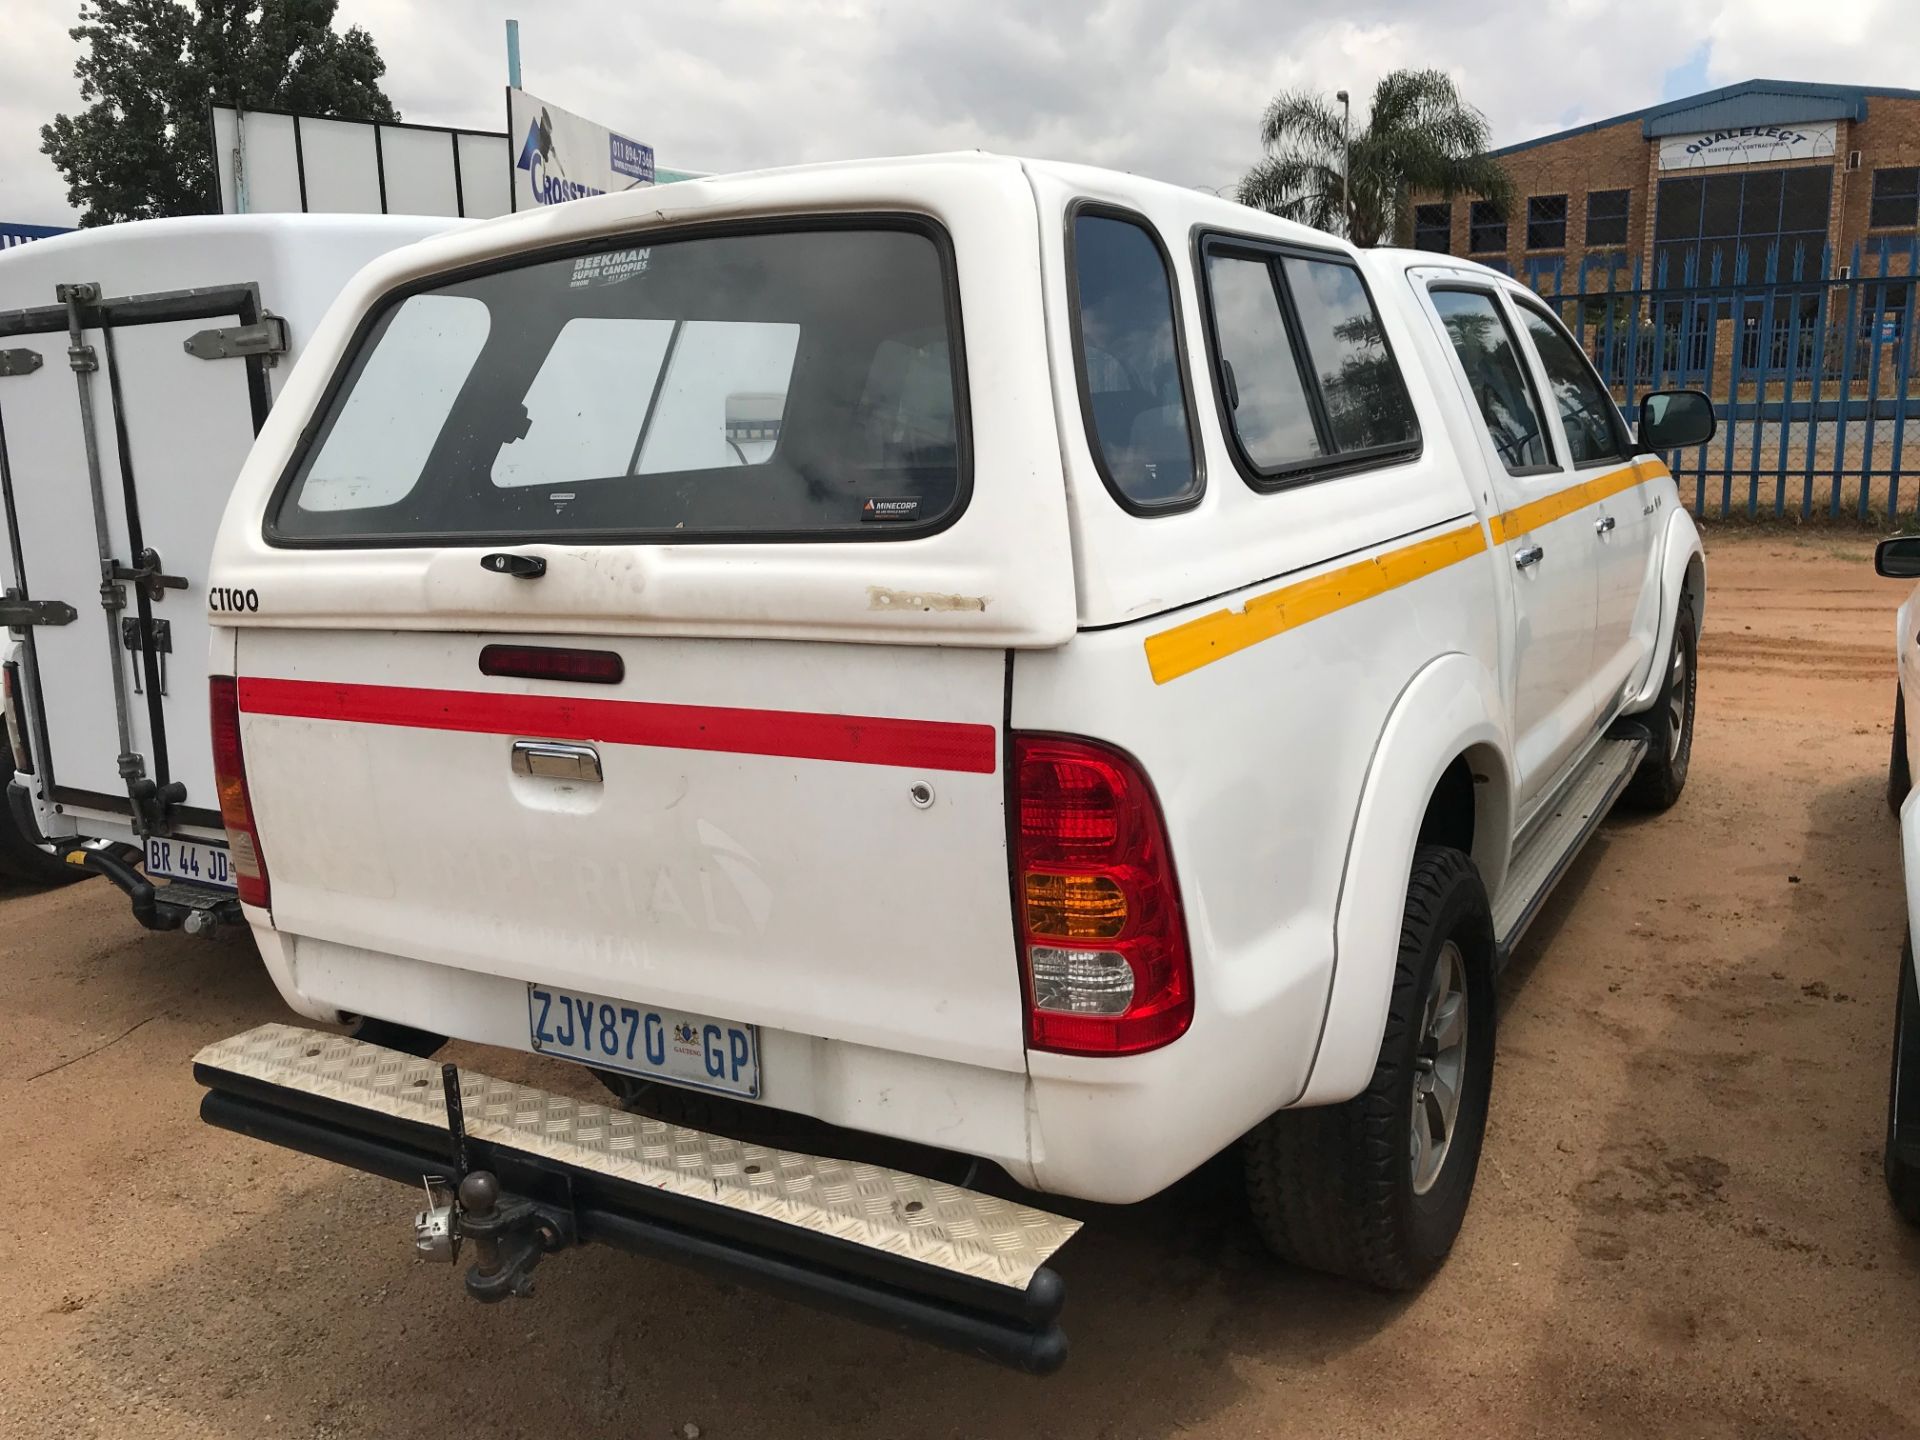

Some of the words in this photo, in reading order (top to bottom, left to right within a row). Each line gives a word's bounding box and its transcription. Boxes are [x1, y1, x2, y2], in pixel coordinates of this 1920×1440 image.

[612, 140, 624, 159] 011
[1686, 126, 1807, 154] QUALELECT
[572, 269, 600, 280] SUPER
[602, 261, 648, 276] CANOPIES
[574, 248, 651, 270] BEEKMAN
[209, 586, 259, 612] C1100
[151, 840, 171, 872] BR
[180, 845, 199, 877] 44
[208, 850, 228, 882] JD
[533, 990, 666, 1066] ZJY870
[703, 1024, 749, 1082] GP
[674, 1046, 702, 1057] GAUTENG
